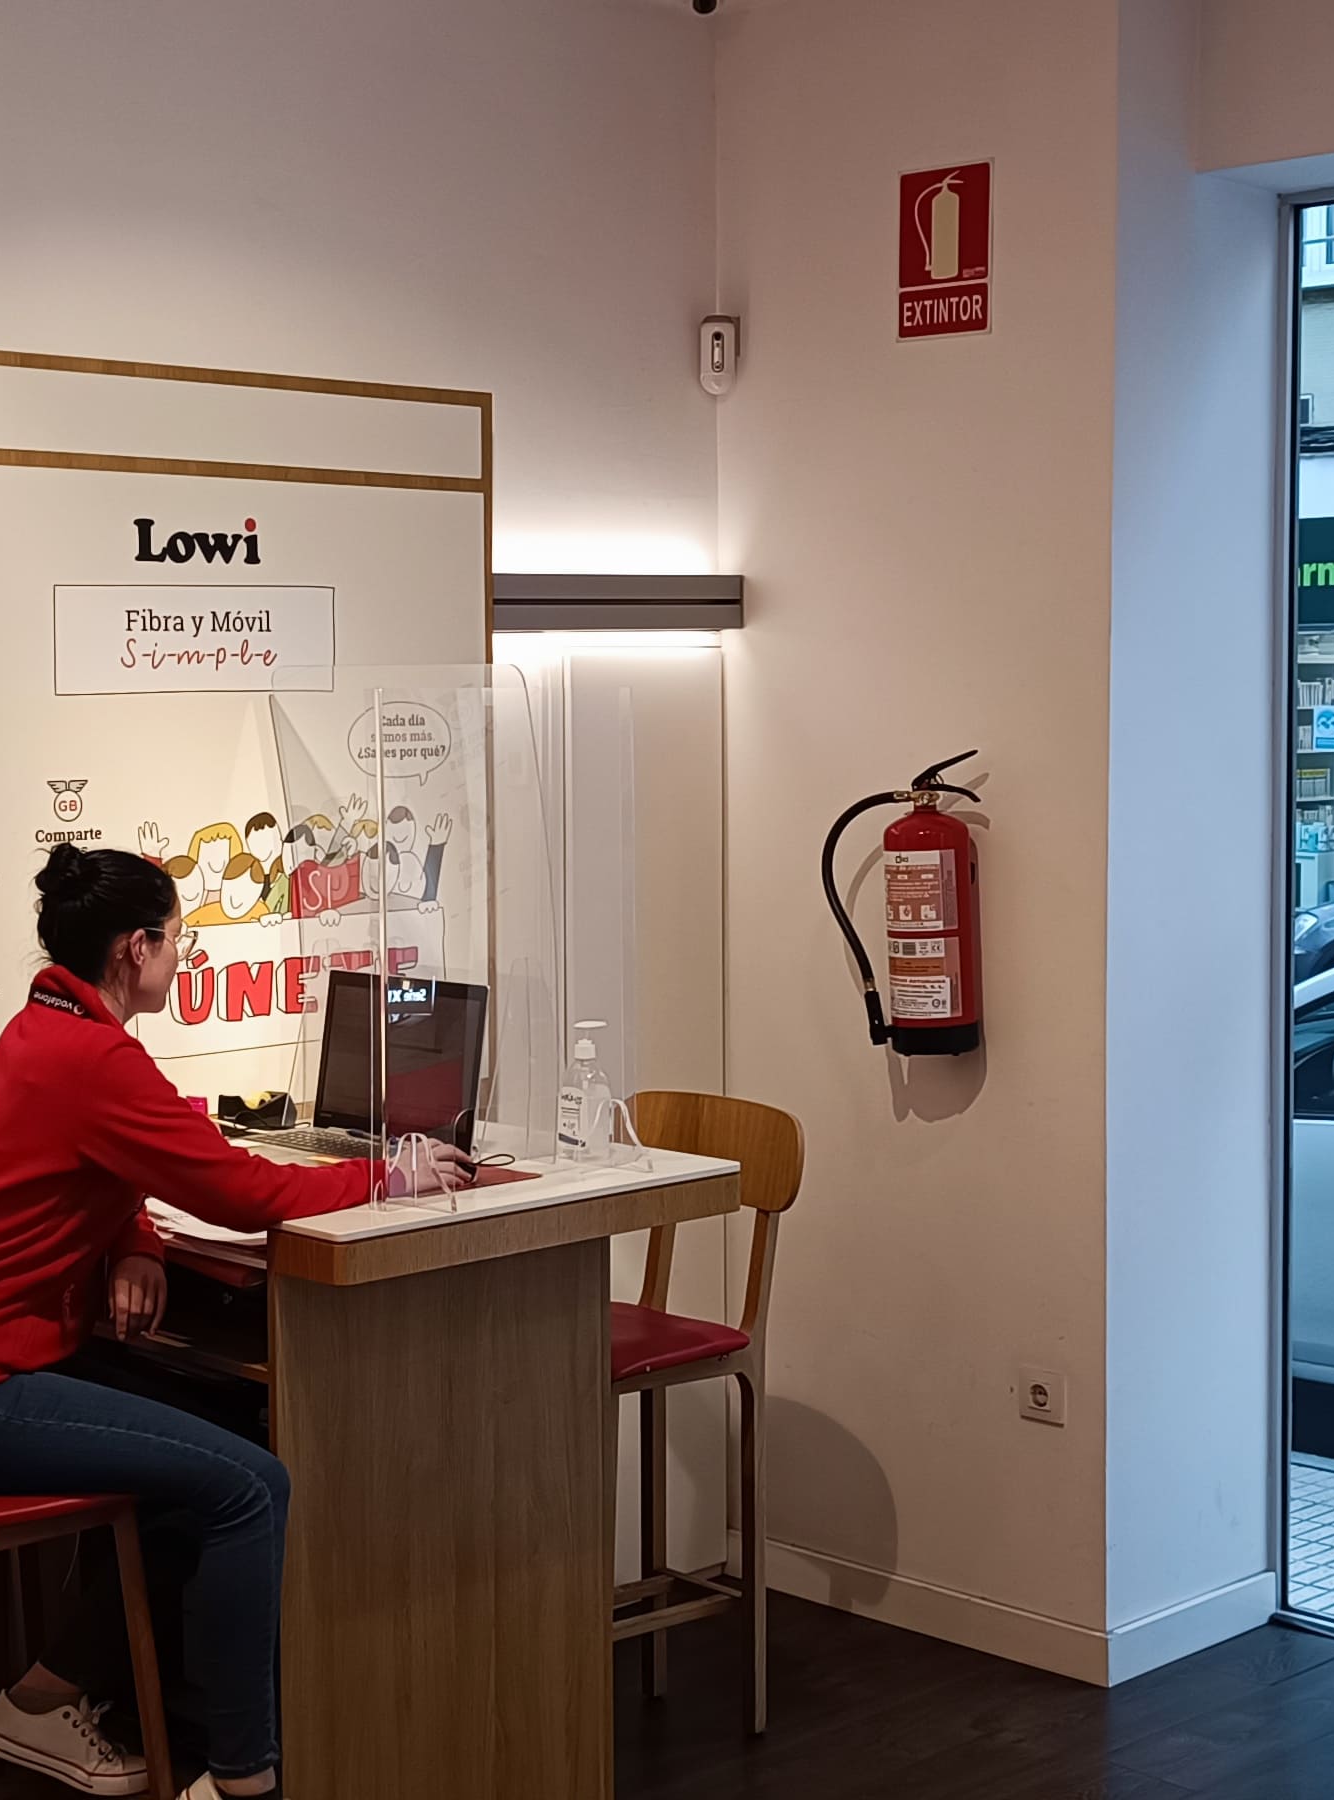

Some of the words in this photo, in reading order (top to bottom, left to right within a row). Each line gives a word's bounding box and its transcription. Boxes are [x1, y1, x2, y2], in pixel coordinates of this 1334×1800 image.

[903, 294, 983, 328] EXTINTOR
[134, 517, 262, 566] Lowi
[125, 608, 185, 634] Fibra
[191, 616, 204, 639] y
[210, 608, 272, 634] Móvil
[408, 713, 426, 727] día
[370, 731, 407, 743] smos
[357, 747, 397, 760] ¿Saes
[400, 748, 418, 761] por
[420, 745, 446, 760] qué?
[58, 800, 78, 812] GB
[35, 827, 102, 844] Comparte
[169, 948, 419, 1025] ÚNEE
[33, 991, 74, 1011] vodafone
